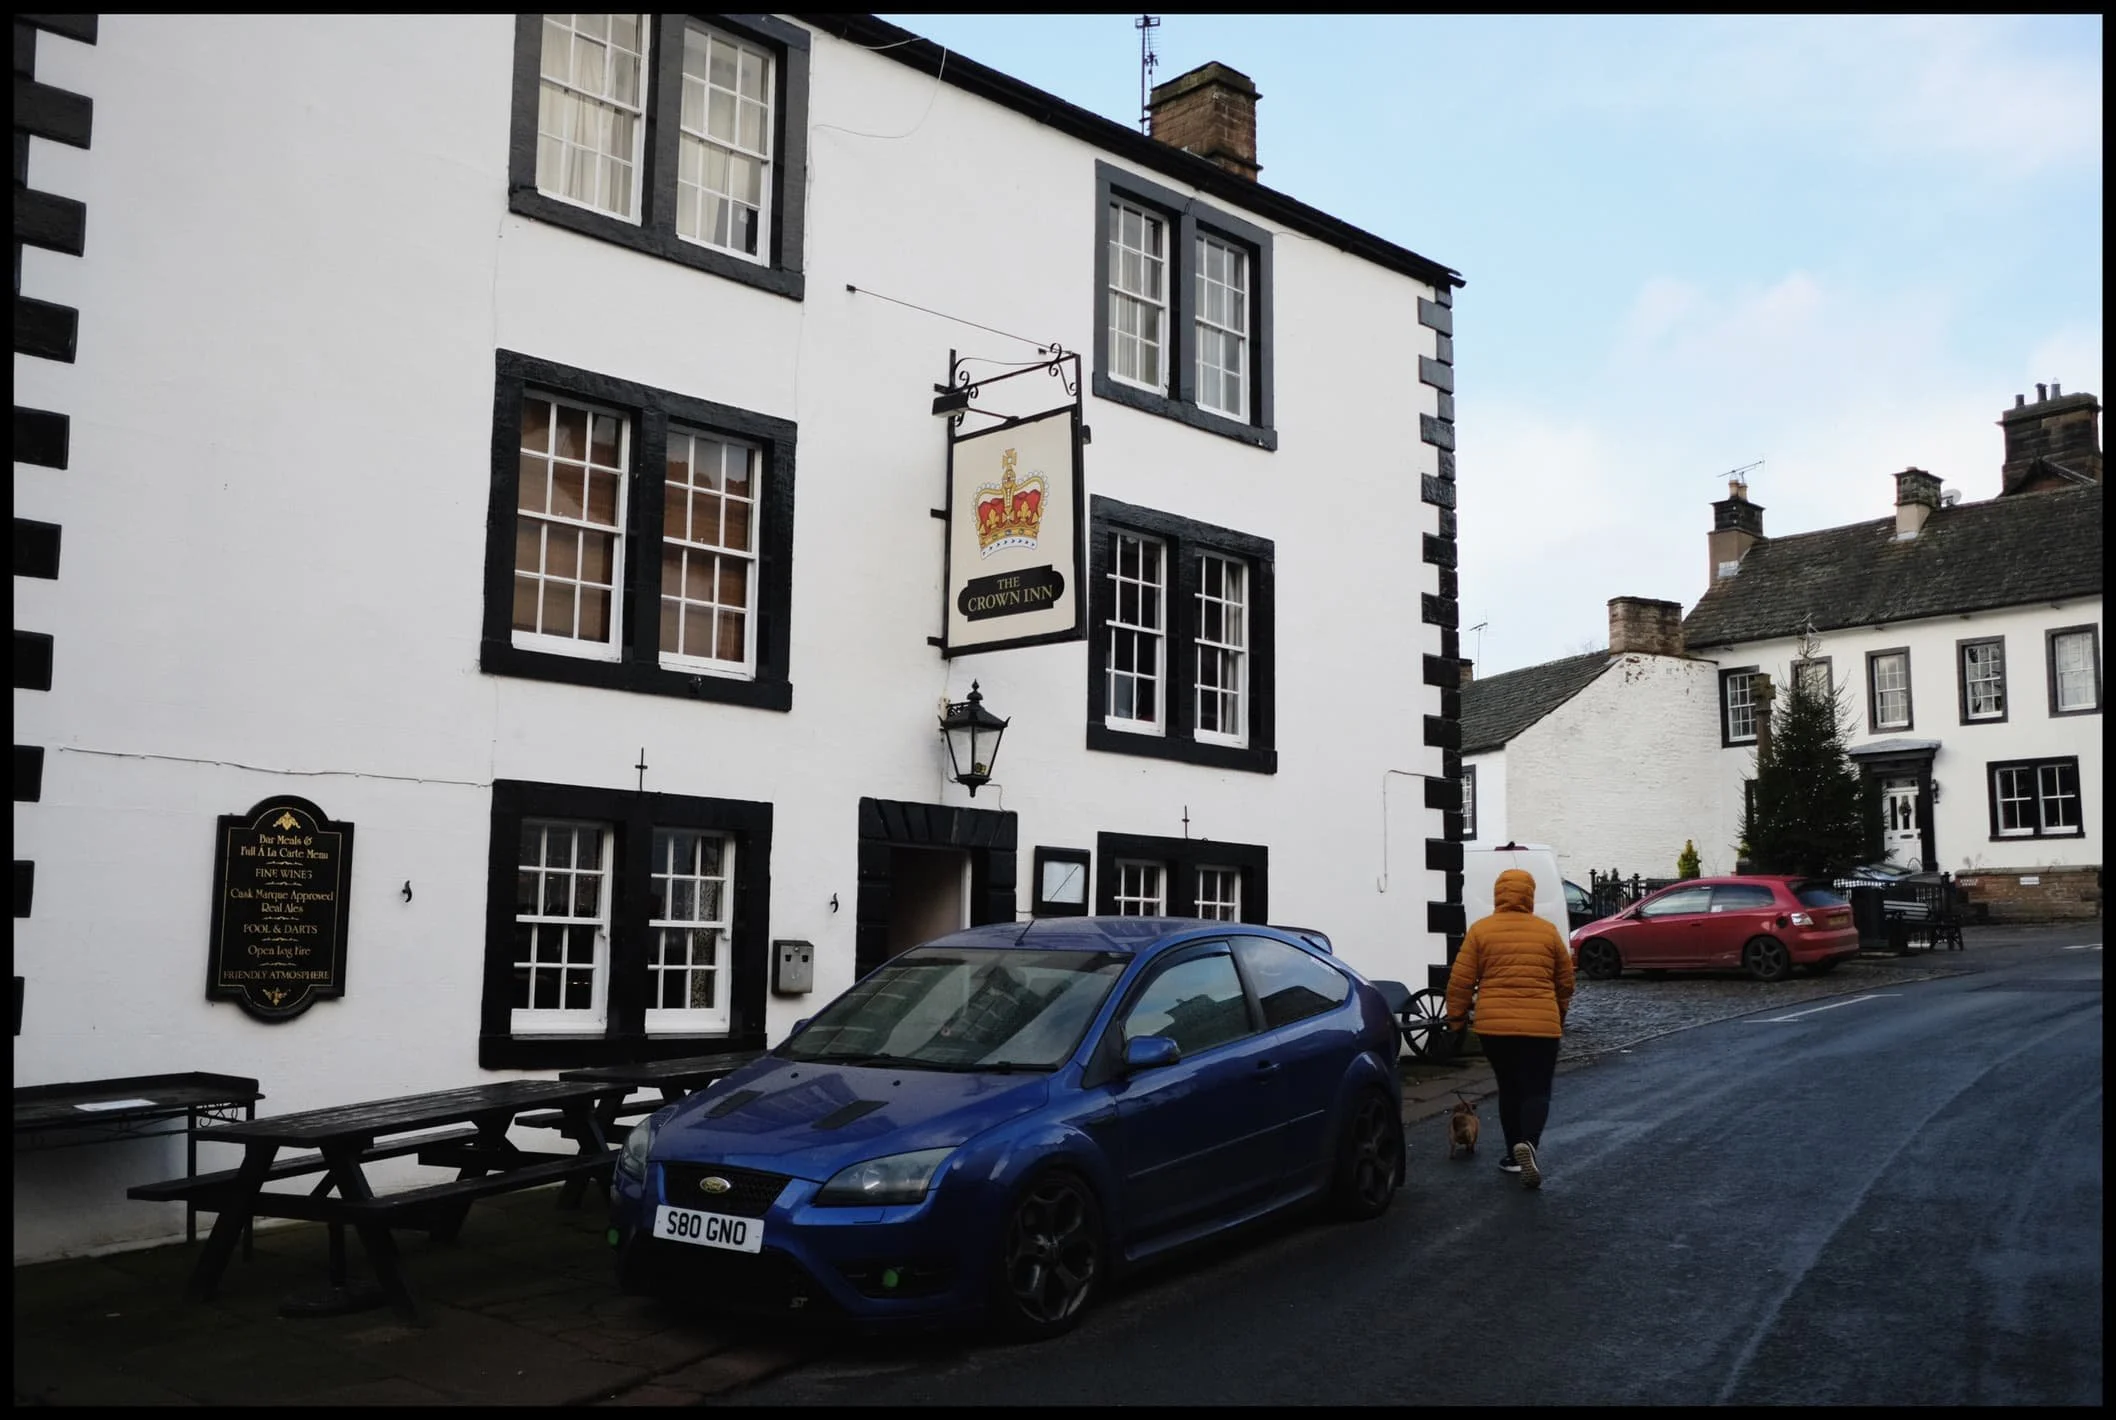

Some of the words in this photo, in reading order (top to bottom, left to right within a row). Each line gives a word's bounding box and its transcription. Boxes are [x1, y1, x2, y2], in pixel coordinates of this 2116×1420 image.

[997, 576, 1020, 590] THE
[968, 590, 1020, 612] CROWN
[1024, 584, 1053, 603] INN
[259, 834, 274, 844] Bar
[276, 835, 302, 846] Meals
[267, 847, 277, 857] La
[279, 848, 304, 858] Carte
[306, 849, 329, 859] Menu
[255, 868, 278, 878] FINE
[280, 869, 313, 879] WINES
[230, 887, 253, 898] Cask
[255, 888, 288, 902] Marque
[290, 890, 334, 903] Approved
[261, 902, 283, 912] Real
[284, 903, 304, 913] Ales
[272, 923, 282, 934] &
[284, 924, 318, 934] DARTS
[247, 945, 275, 957] Open
[277, 945, 293, 958] Log
[223, 970, 268, 980] FRIENDLY
[269, 970, 329, 980] ATMOSPHERE
[666, 1210, 702, 1239] S80
[706, 1217, 748, 1246] GNO
